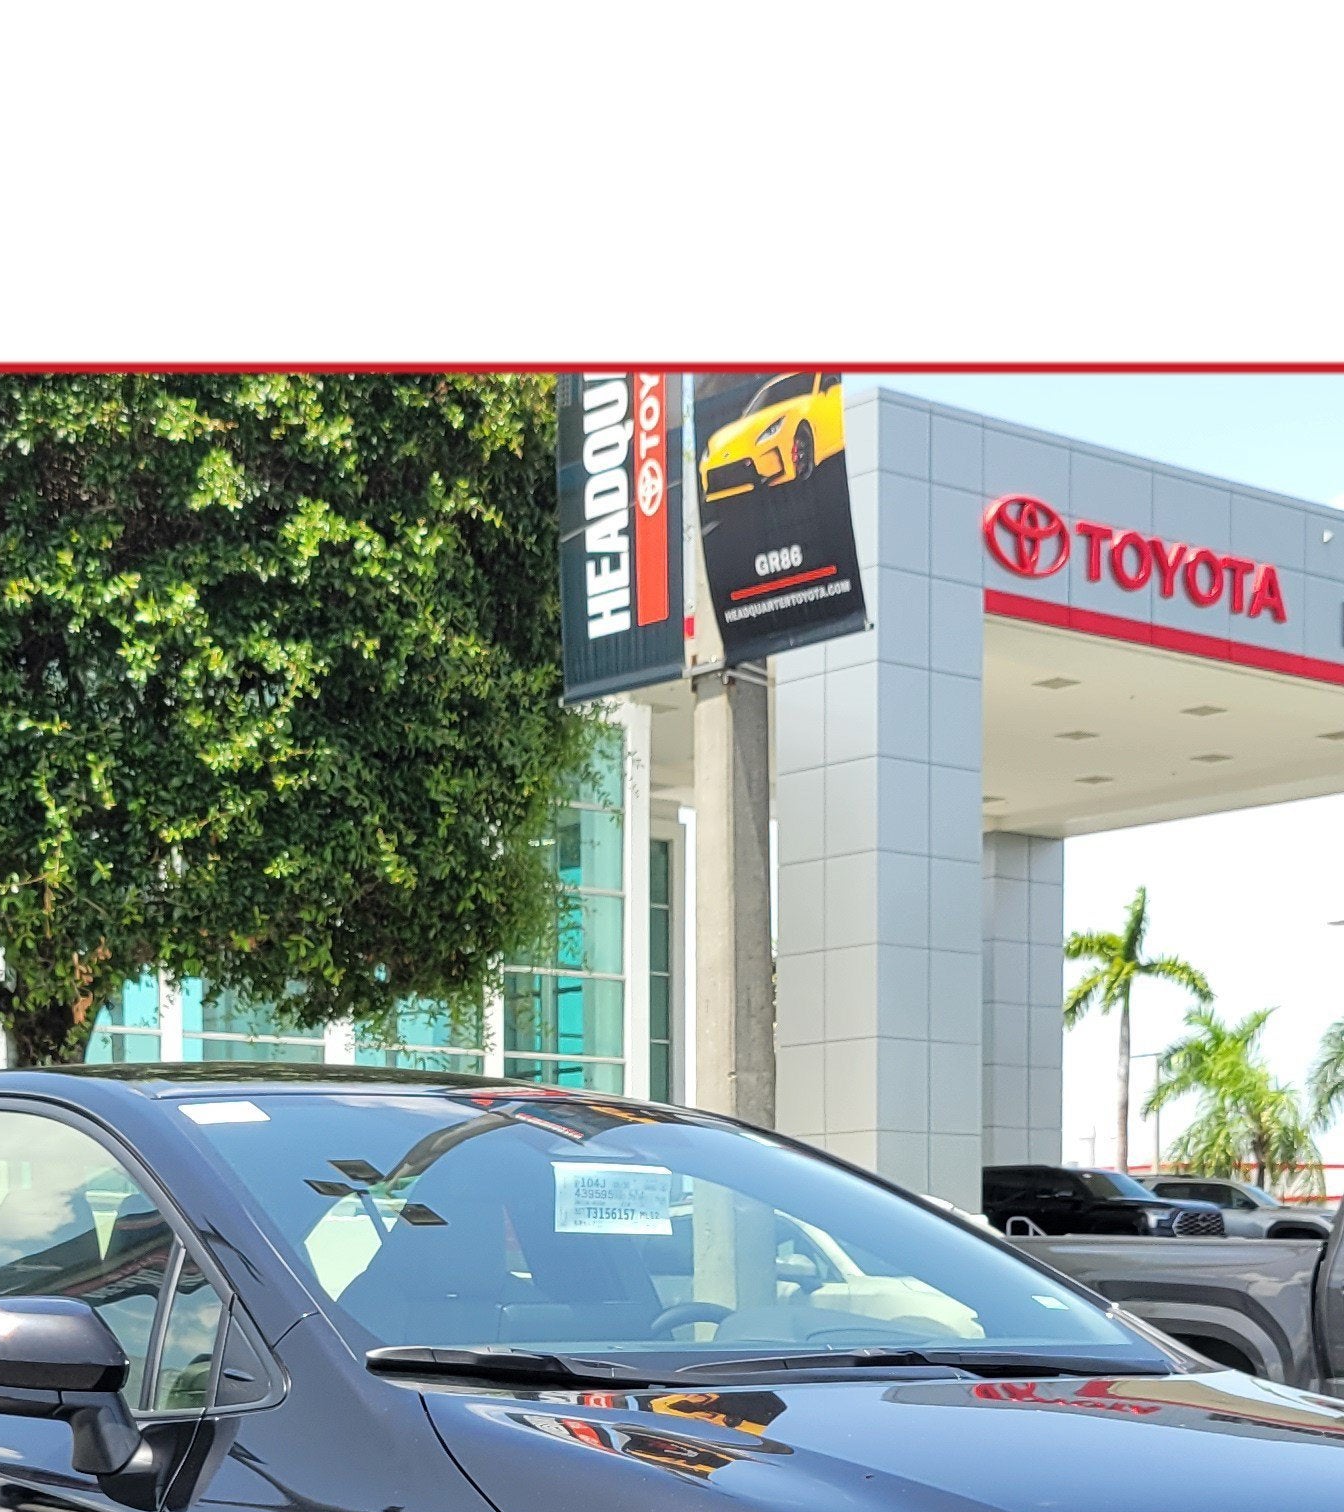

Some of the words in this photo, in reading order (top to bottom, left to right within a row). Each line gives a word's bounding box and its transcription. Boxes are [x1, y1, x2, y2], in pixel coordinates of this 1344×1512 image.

[583, 373, 633, 640] HEADQU
[755, 544, 803, 576] GR86
[1076, 521, 1288, 623] TOYOTA
[724, 579, 852, 624] HEADQUARTERTOYOTA.COM
[587, 1207, 636, 1220] T3156157
